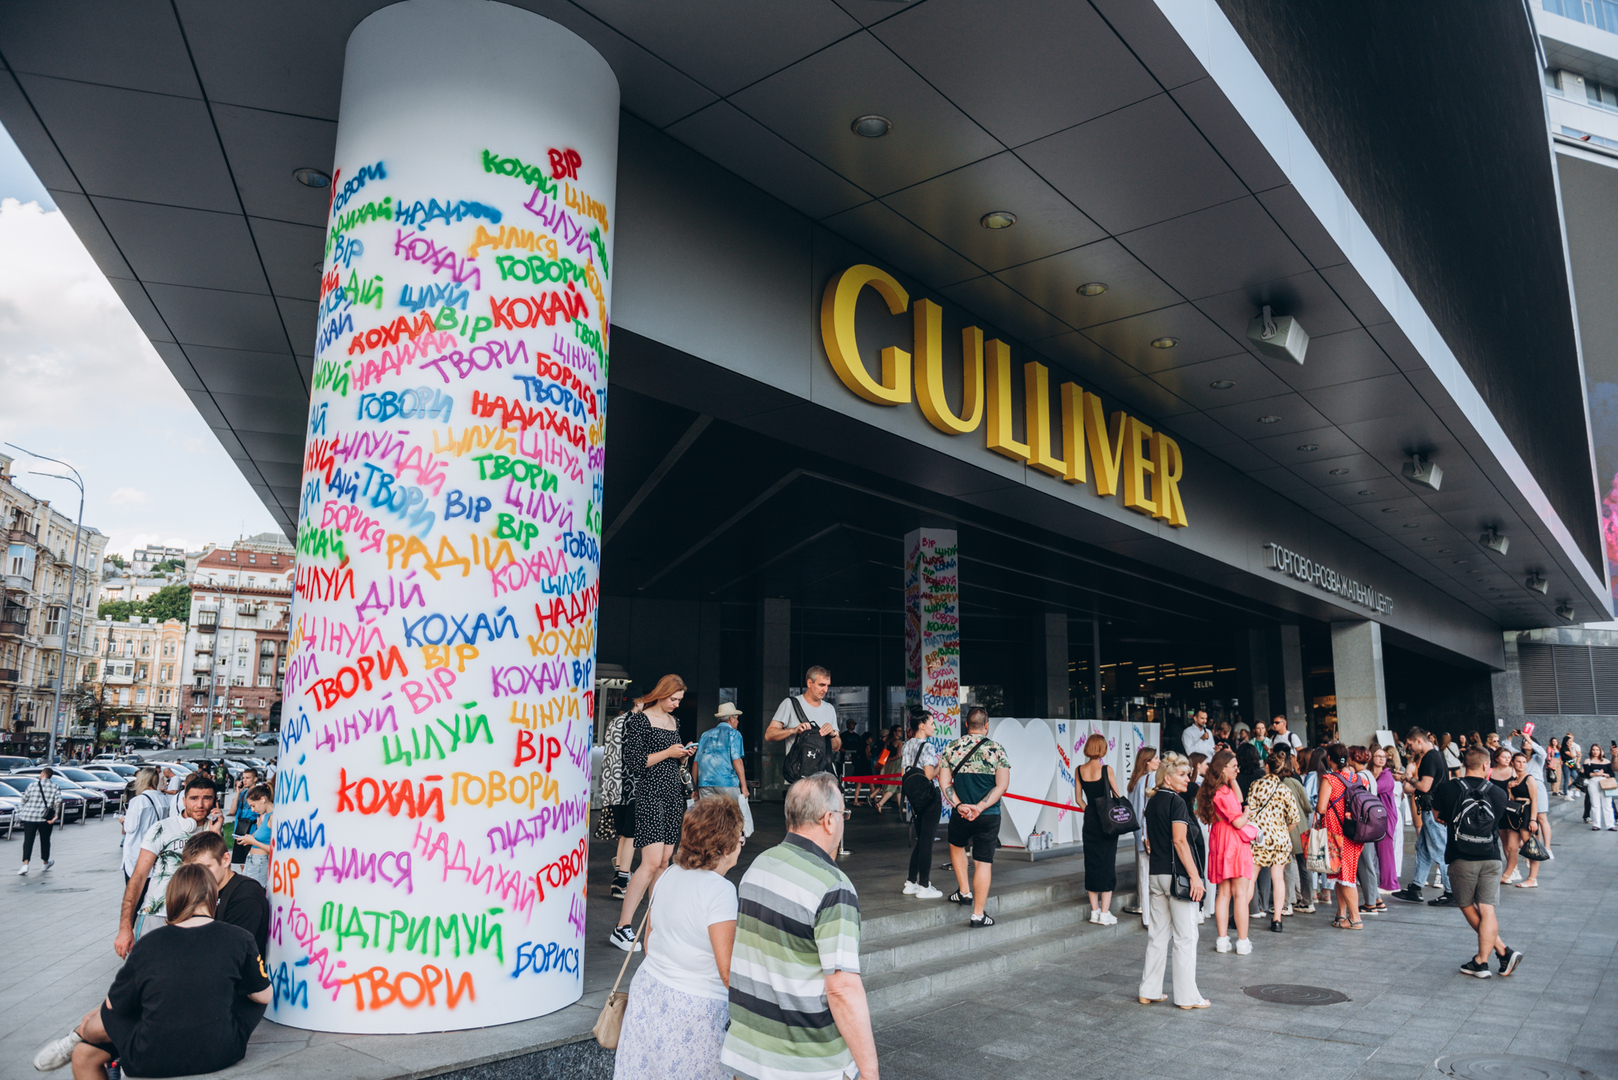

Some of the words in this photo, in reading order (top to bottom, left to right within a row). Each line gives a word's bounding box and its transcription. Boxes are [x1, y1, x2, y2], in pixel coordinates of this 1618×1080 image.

[333, 161, 388, 217] ГОВОРИ
[483, 149, 557, 200] КОХАЙ
[547, 148, 582, 181] ВІР
[467, 225, 558, 262] ДІЛИСЯ
[524, 187, 593, 265] ЦІЛУЙ
[334, 234, 364, 269] ВІР
[394, 228, 481, 291] КОХАЙ
[496, 255, 589, 289] ГОВОРИ
[434, 305, 492, 343] ВІР
[489, 280, 590, 331] КОХАЙ
[347, 309, 437, 356] КОХАЙ
[553, 332, 598, 382] ЦІНУЙ
[351, 330, 458, 391] НАДИХАЙ
[419, 340, 529, 384] ТВОРИ
[358, 386, 454, 424] ГОВОРИ
[512, 375, 587, 424] ТВОРИ
[535, 352, 598, 421] БОРИСЯ
[820, 263, 1188, 528] GULLIVER
[432, 425, 519, 458] ЦІЛУЙ
[471, 389, 586, 453] НАДИХАЙ
[334, 430, 410, 466] ЦІЛУЙ
[519, 424, 584, 484] ЦІНУЙ
[470, 453, 558, 494] ТВОРИ
[361, 462, 437, 538] ТВОРИ
[443, 489, 492, 523] ВІР
[504, 474, 574, 532] ЦІЛУЙ
[320, 500, 386, 554] БОРИСЯ
[498, 512, 539, 550] ВІР
[295, 554, 356, 603] ЦІЛУЙ
[491, 533, 569, 598] КОХАЙ
[1270, 542, 1375, 611] ТОРГОВО-РОЗВАЖАЛЬНИЙ
[355, 570, 426, 623] ДІЙ
[302, 612, 387, 659] ЦІНУЙ
[402, 605, 520, 648] КОХАЙ
[526, 618, 596, 658] КОХАЙ
[305, 645, 409, 712] ТВОРИ
[421, 643, 480, 673] ВІР
[490, 653, 570, 698] КОХАЙ
[572, 657, 592, 690] ВІР
[401, 667, 457, 715] ВІР
[509, 686, 580, 731] ЦІНУЙ
[315, 692, 399, 753] ЦІНУЙ
[382, 701, 495, 767] ЦІЛУЙ
[513, 728, 562, 774] ВІР
[336, 767, 446, 823] КОХАЙ
[450, 770, 560, 810] ГОВОРИ
[276, 808, 326, 852] КОХАЙ
[486, 788, 587, 860] ПІДТРИМУЙ
[272, 857, 300, 898] ВІР
[314, 841, 414, 895] ДІЛИСЯ
[412, 820, 538, 926] НАДИХАЙ
[287, 898, 347, 1002] КОХАЙ
[319, 900, 505, 967] ПІДТРИМУЙ
[510, 941, 580, 981] БОРИСЯ
[338, 965, 476, 1012] ТВОРИ
